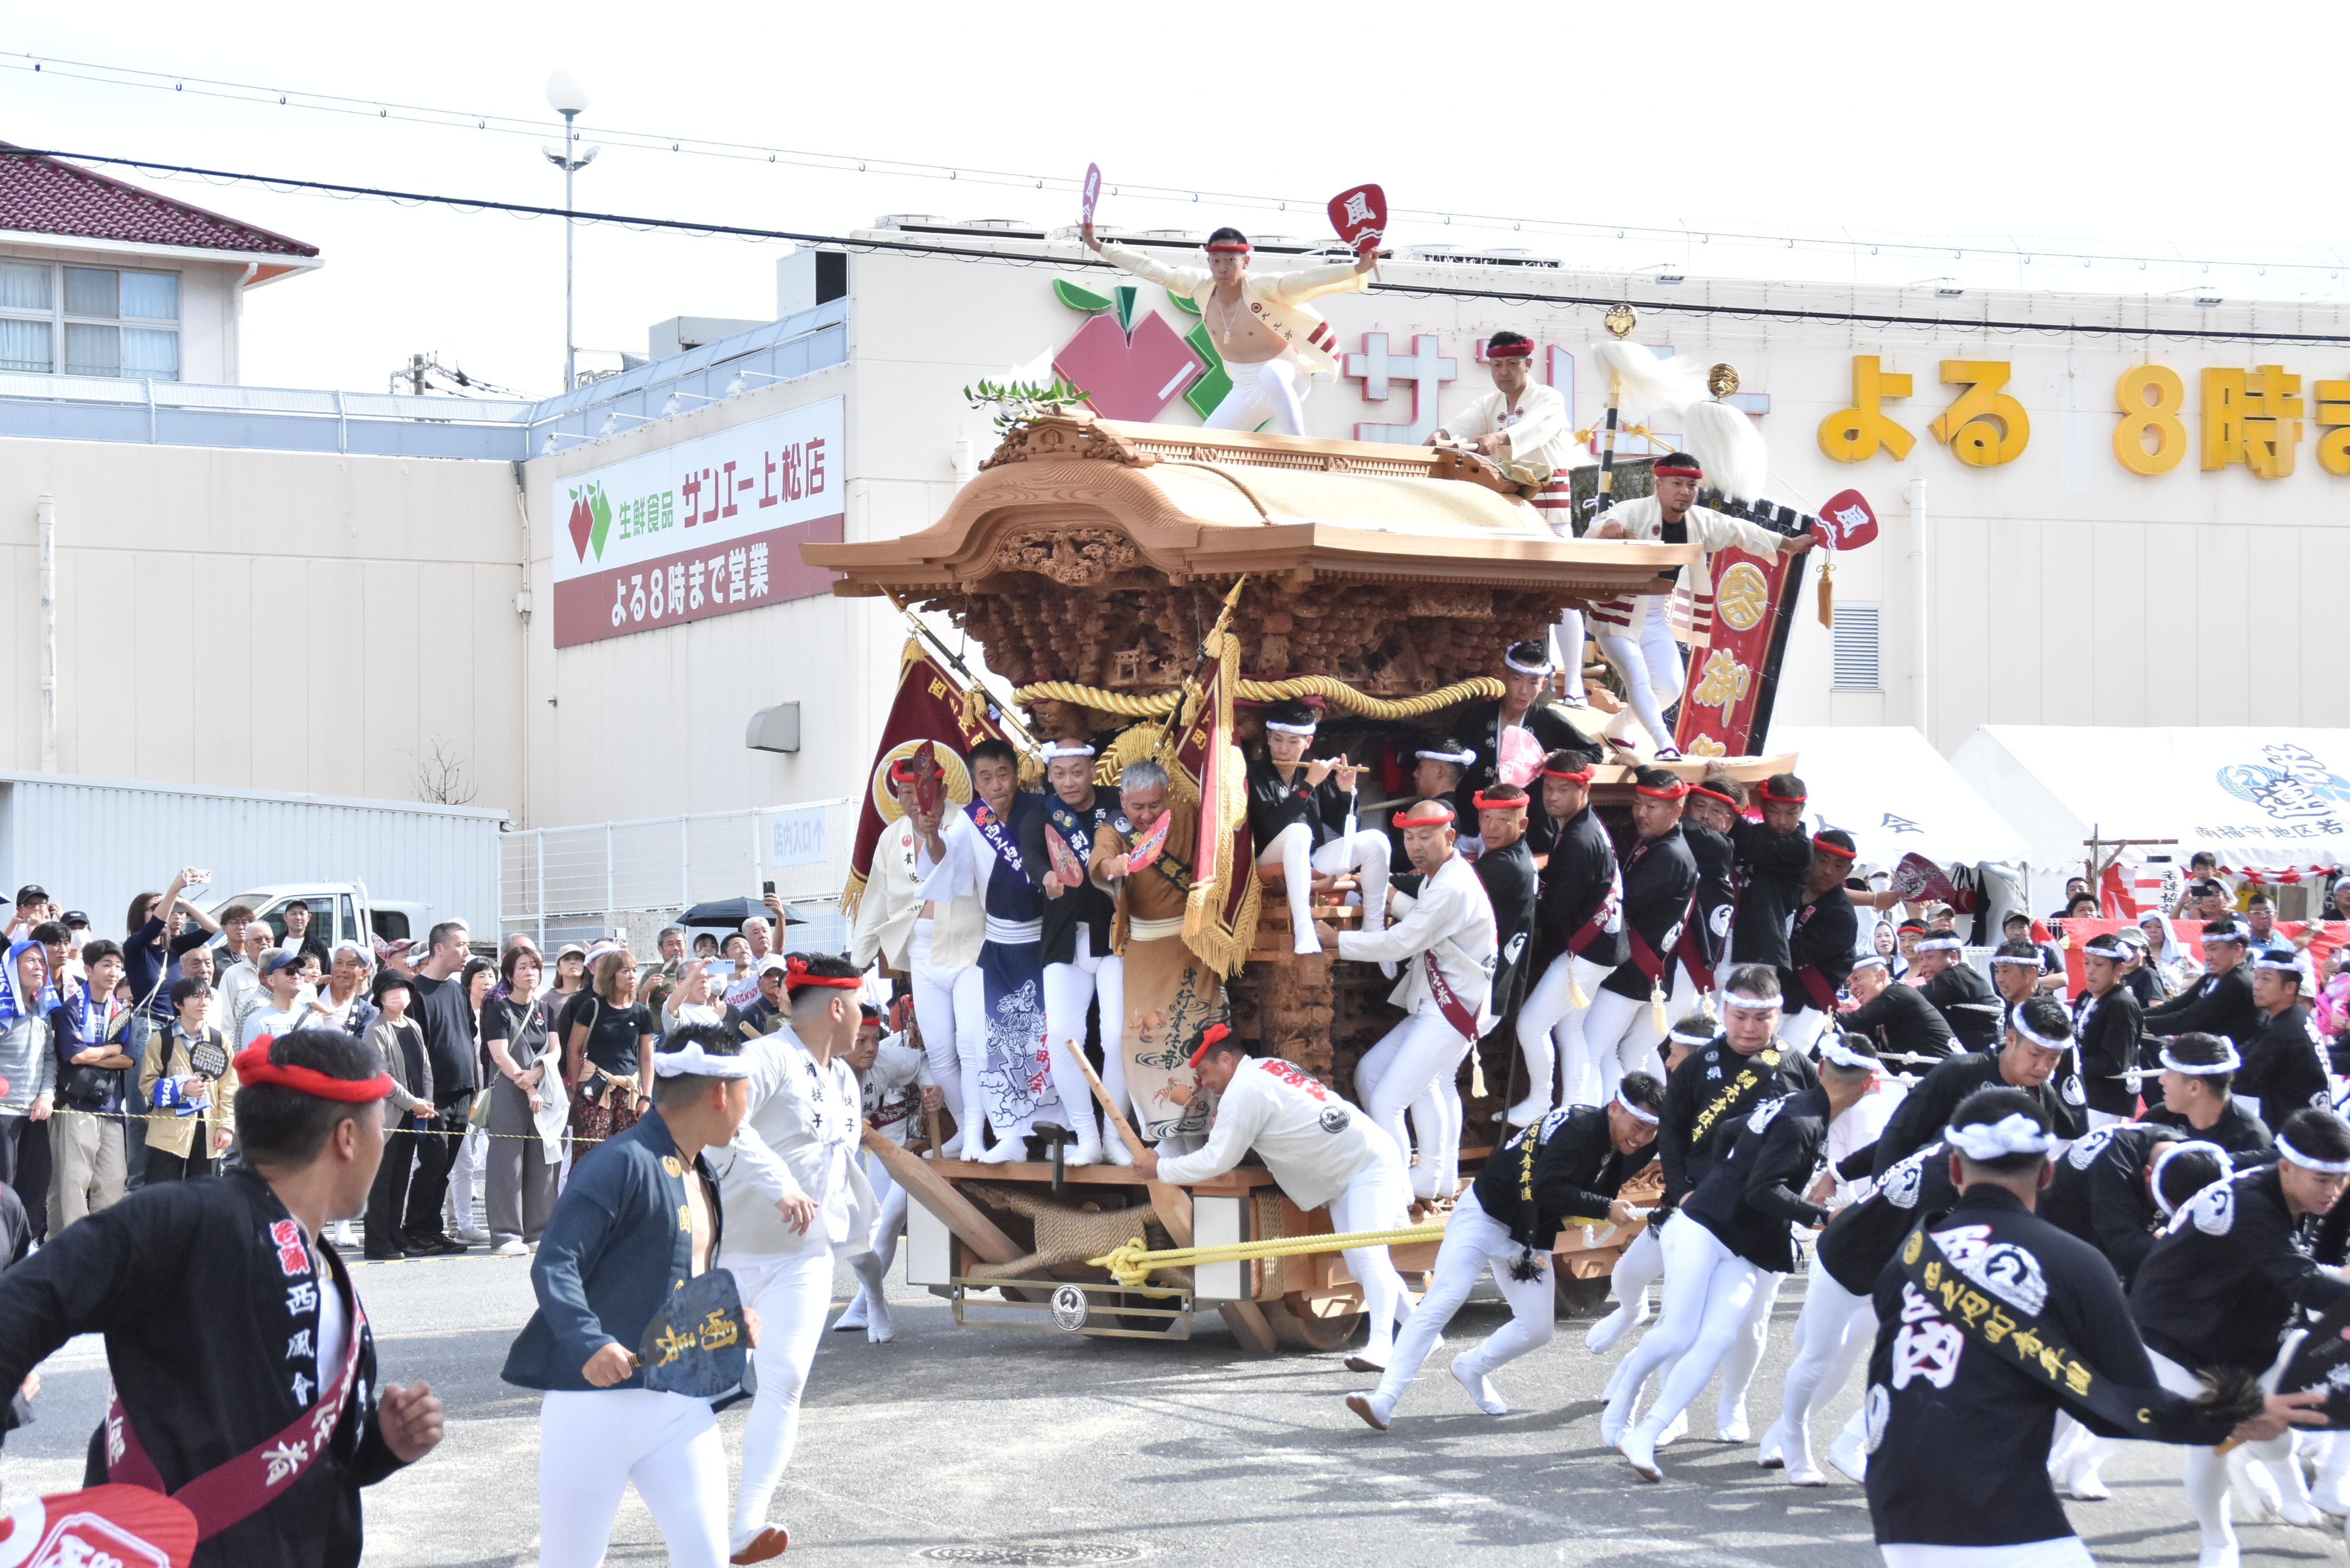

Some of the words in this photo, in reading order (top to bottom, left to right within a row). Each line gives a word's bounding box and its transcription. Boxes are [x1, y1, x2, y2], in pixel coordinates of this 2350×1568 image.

[1343, 191, 1376, 228] 風
[619, 490, 673, 540] 生鮮食品
[682, 437, 825, 528] サンエー上松店
[612, 542, 769, 627] よる8時まで営業
[1484, 736, 1495, 778] 鳴物
[774, 820, 811, 857] 店内入口
[1160, 966, 1197, 1071] 曳行責任者
[285, 1281, 318, 1406] 西風會
